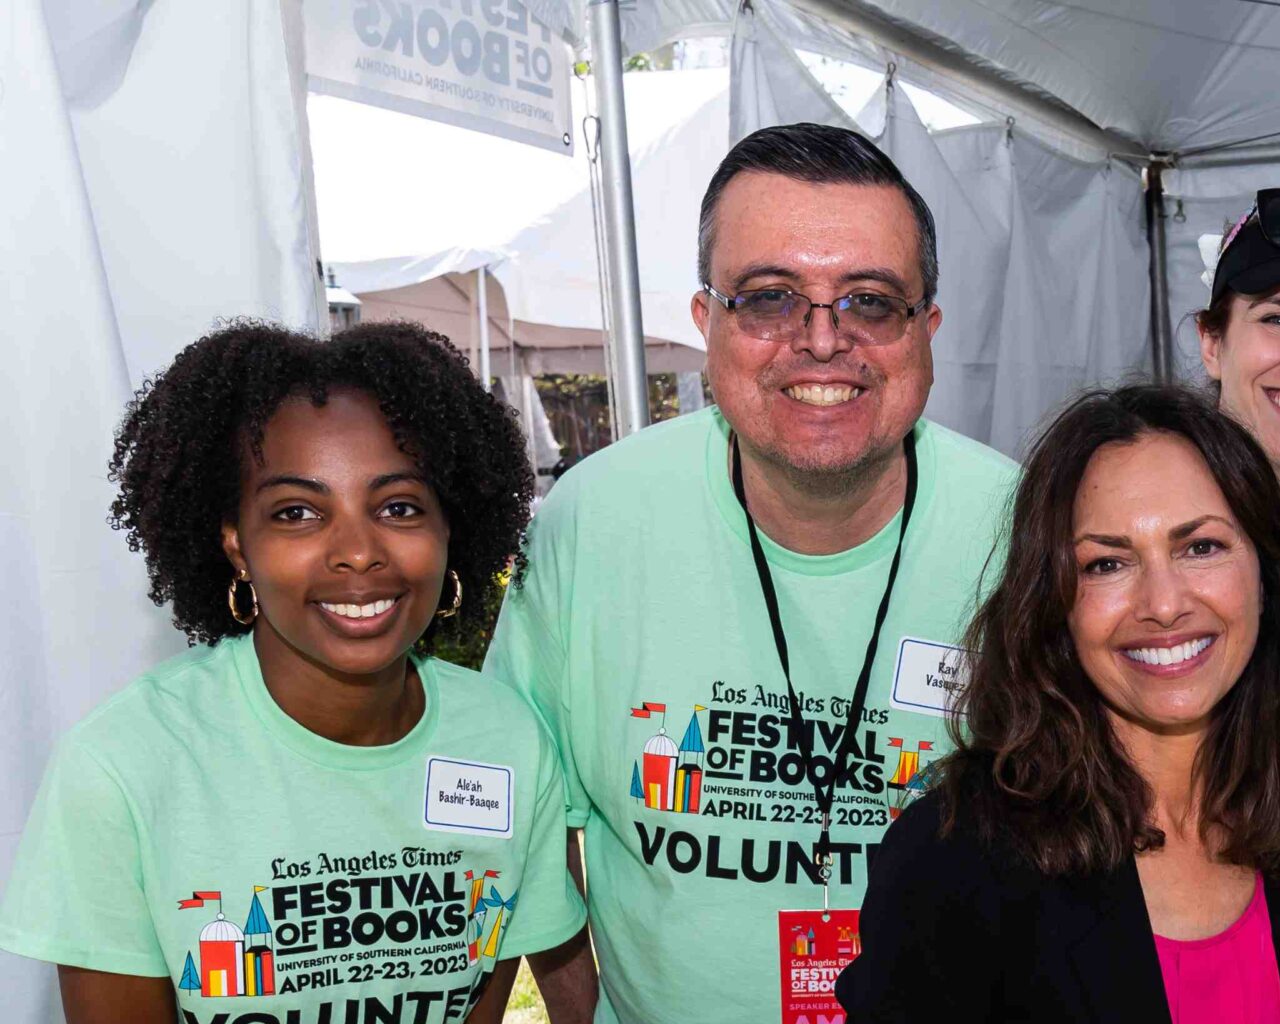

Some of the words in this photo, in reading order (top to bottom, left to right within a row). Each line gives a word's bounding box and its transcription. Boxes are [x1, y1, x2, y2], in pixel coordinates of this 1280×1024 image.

[711, 680, 747, 704] Los
[751, 684, 825, 715] Angles
[708, 709, 885, 764] FESTIVAL
[707, 746, 745, 771] OF
[749, 749, 885, 795] BOOKS
[703, 784, 762, 798] UNIVERSITY
[765, 789, 778, 800] OF
[778, 791, 816, 802] SOUTHE
[702, 799, 768, 822] APRIL
[836, 808, 889, 828] 2023
[271, 857, 311, 881] Los
[316, 850, 397, 876] Angeles
[401, 846, 464, 868] Times
[272, 871, 466, 921] FESTIVAL
[275, 920, 318, 947] OF
[322, 903, 467, 950] BOOKS
[276, 955, 338, 973] UNIVERSITY
[340, 952, 354, 963] OF
[356, 947, 412, 961] SOUTHERN
[414, 940, 467, 956] CALIFORNIA
[279, 968, 344, 995] APRIL
[347, 961, 416, 983] 22-23,
[419, 953, 469, 976] 2023
[791, 959, 806, 968] Los
[807, 958, 837, 968] Angeles
[791, 980, 807, 990] OF
[789, 1002, 831, 1011] SPEAKER
